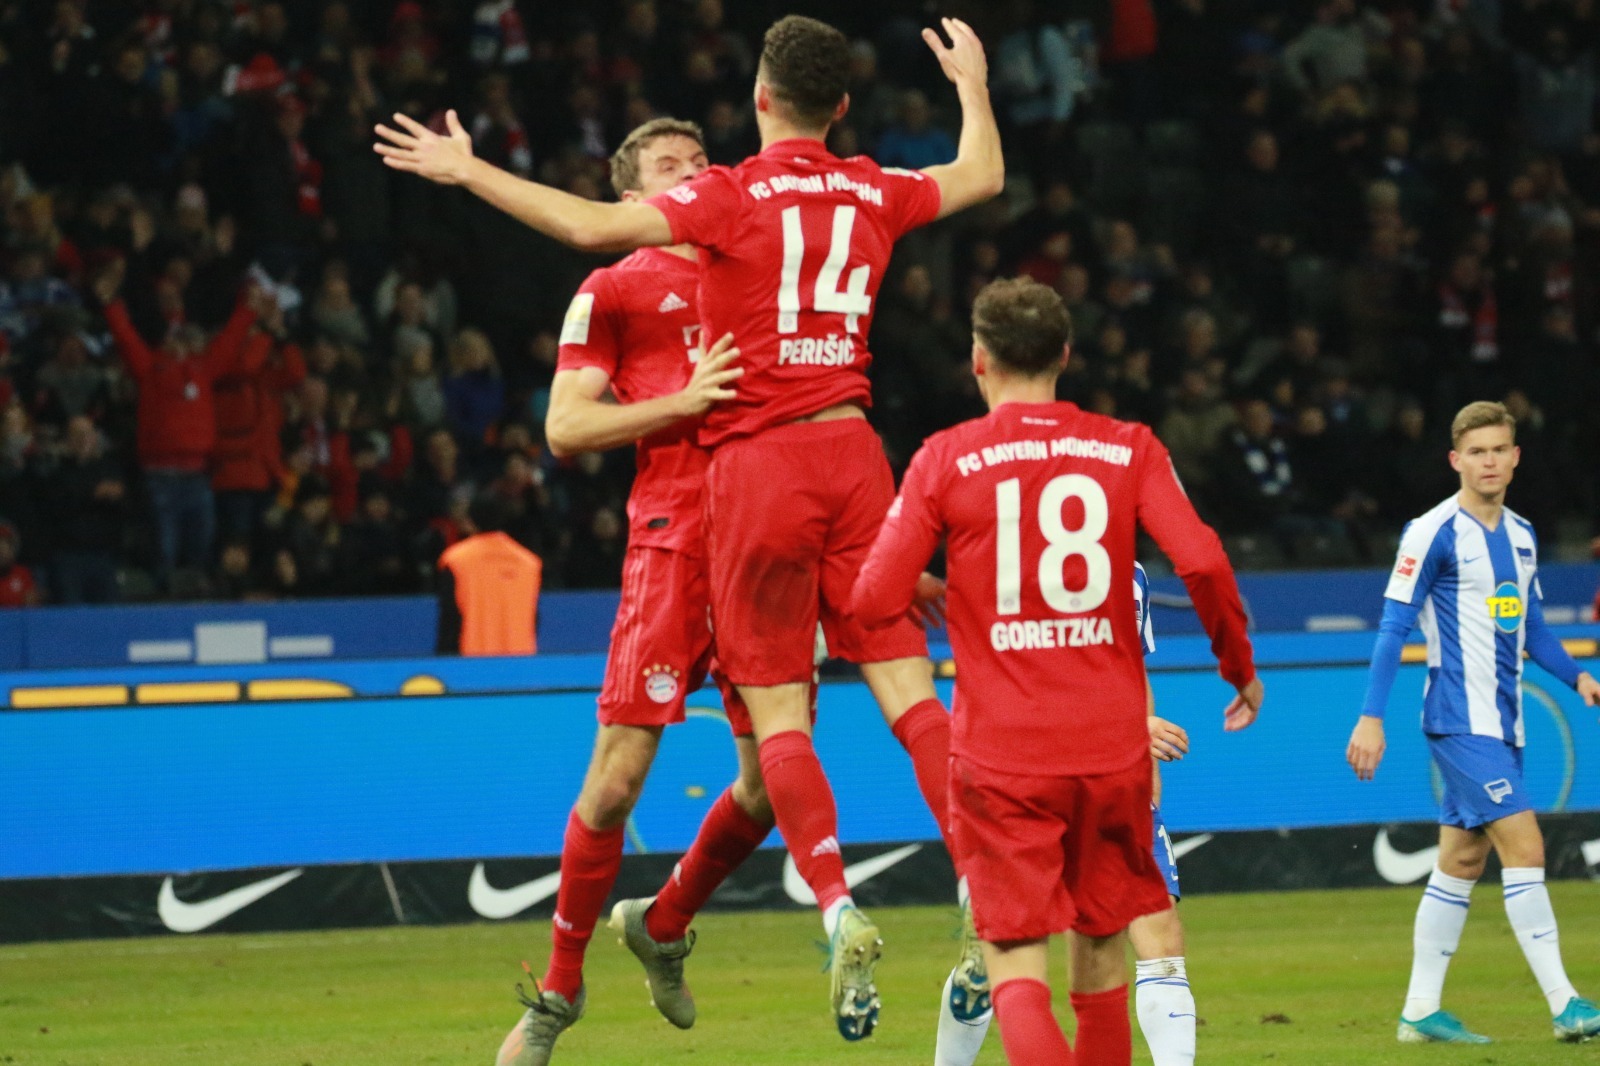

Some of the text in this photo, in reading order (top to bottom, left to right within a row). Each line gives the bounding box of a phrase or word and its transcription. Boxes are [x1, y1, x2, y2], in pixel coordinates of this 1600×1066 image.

[748, 181, 771, 200] FC
[777, 205, 872, 334] 14
[956, 436, 1133, 477] FC BAYERN MÜNCHEN
[995, 473, 1112, 615] 18
[990, 617, 1114, 652] GORETZKA
